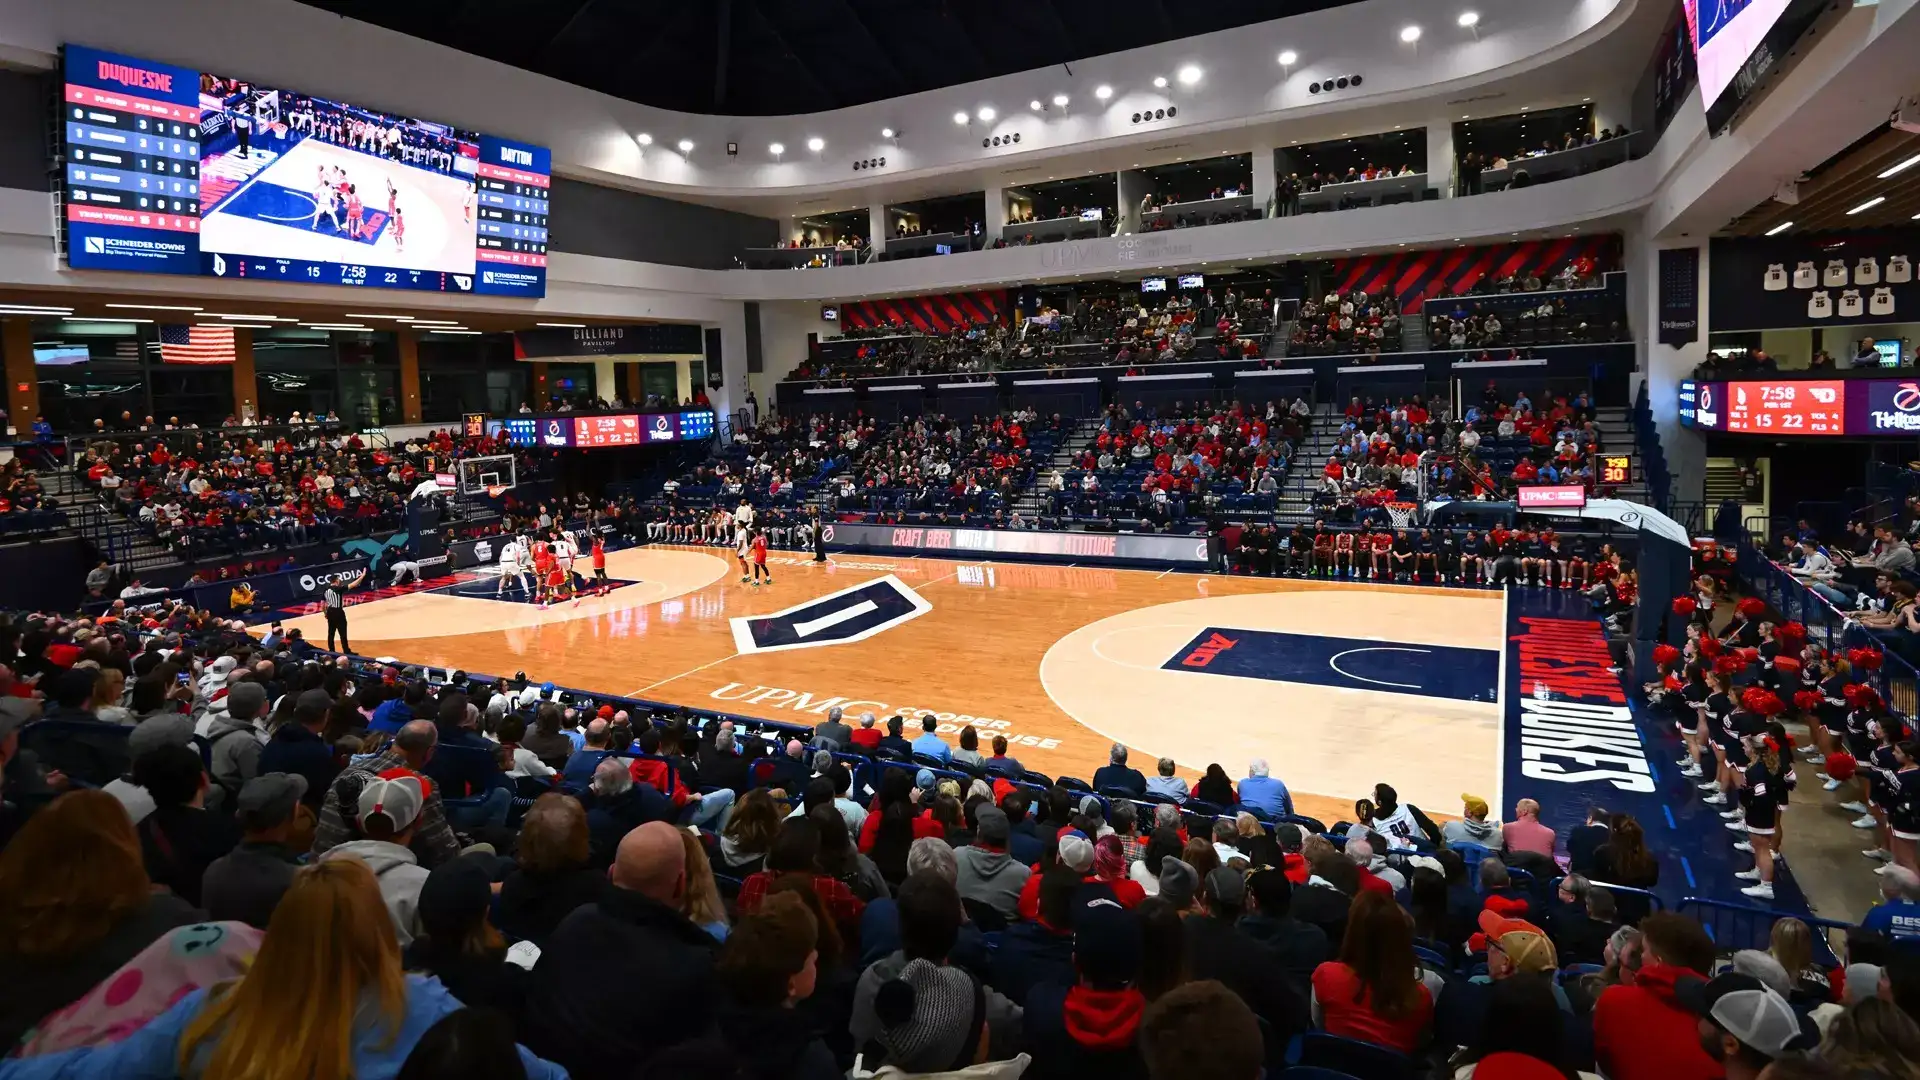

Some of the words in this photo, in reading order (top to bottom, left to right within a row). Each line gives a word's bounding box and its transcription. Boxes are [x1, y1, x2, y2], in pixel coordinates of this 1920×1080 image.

[98, 60, 173, 93] DUQUESNE
[501, 146, 532, 166] DAYTON
[105, 238, 154, 249] SCHNEIDER
[154, 242, 186, 252] DOWNS
[279, 265, 286, 273] 6
[306, 266, 320, 277] 15
[340, 265, 366, 278] 7:58
[384, 272, 397, 283] 22
[1760, 387, 1795, 400] 7:58
[1754, 413, 1773, 427] 15
[1782, 414, 1803, 428] 22
[468, 423, 480, 436] 30
[594, 434, 605, 443] 15
[610, 434, 622, 443] 22
[1606, 458, 1628, 468] 7:58
[1605, 468, 1623, 481] 30
[1521, 492, 1555, 501] UPMC
[892, 528, 923, 547] CRAFT
[926, 528, 951, 548] BEER
[956, 529, 982, 547] WITH
[1064, 535, 1117, 556] ATTITUDE
[1509, 616, 1627, 703] DUQUESNE
[709, 682, 888, 721] UPMC
[895, 707, 1012, 730] COOPER
[1520, 697, 1656, 793] DUKES
